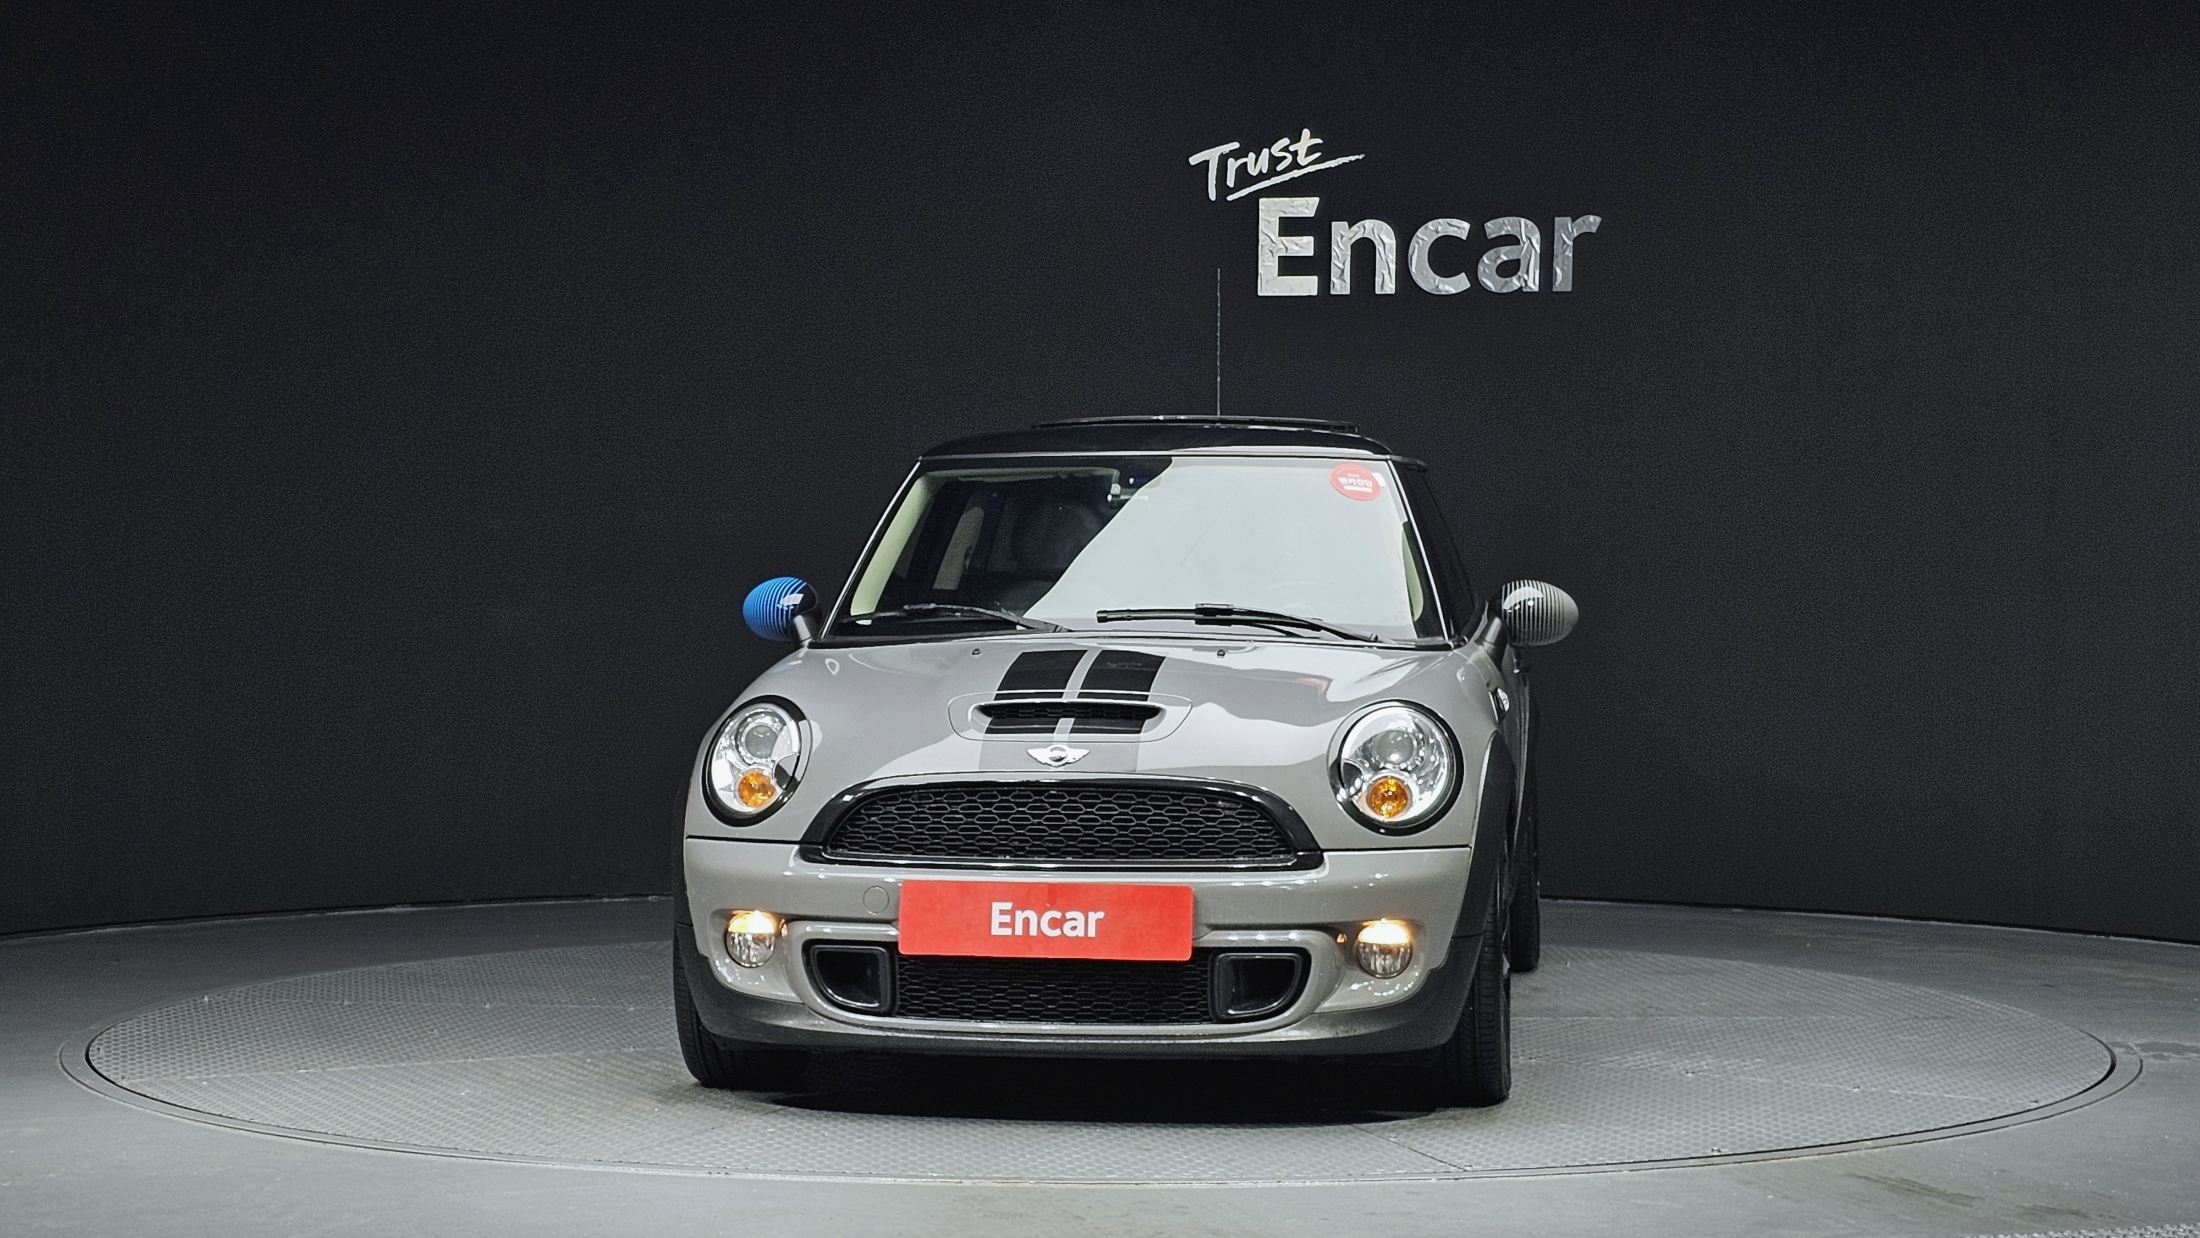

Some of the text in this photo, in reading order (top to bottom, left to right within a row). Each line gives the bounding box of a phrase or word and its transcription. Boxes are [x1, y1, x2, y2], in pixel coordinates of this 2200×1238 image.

[1188, 127, 1325, 202] Trust
[1257, 196, 1602, 297] Encar
[990, 901, 1106, 938] Encar
